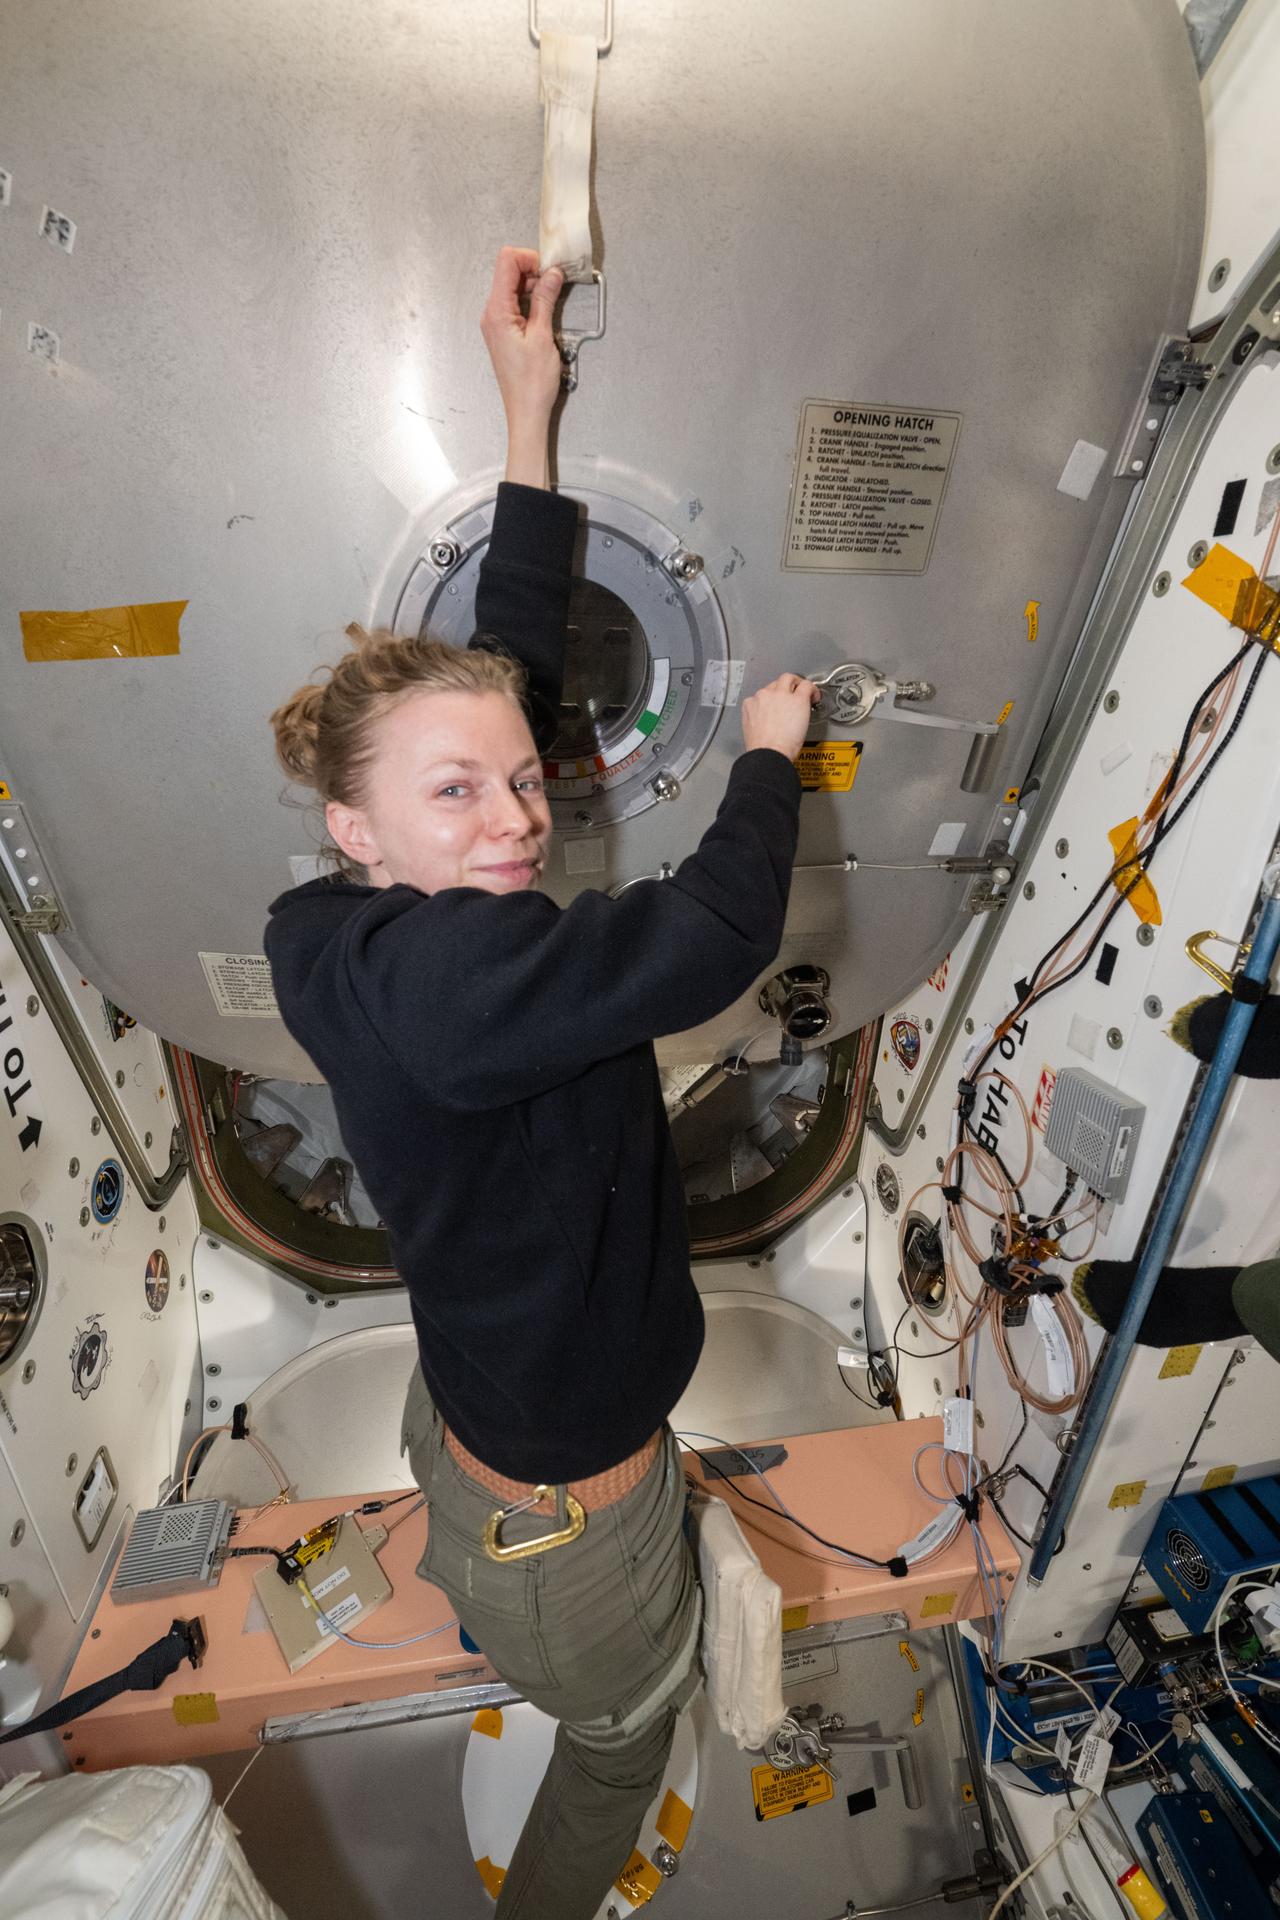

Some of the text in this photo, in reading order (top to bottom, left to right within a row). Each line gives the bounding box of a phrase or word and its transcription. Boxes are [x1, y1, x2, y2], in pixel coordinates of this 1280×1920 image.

[834, 411, 934, 430] OPENING HATCH
[821, 428, 851, 437] PRESSURE
[853, 431, 898, 441] EQUALIZATION
[900, 435, 918, 443] VALVE
[875, 443, 901, 451] Engaged
[851, 450, 879, 459] UNLATCH
[841, 458, 866, 466] HANDLE
[893, 462, 921, 471] UNLATCH
[921, 464, 946, 472] direction
[814, 474, 847, 483] INDICATOR
[854, 477, 890, 486] UNLATCHED.
[842, 494, 887, 503] EQUALIZATION
[650, 689, 678, 741] LATCHED
[840, 710, 858, 718] LATCH
[798, 752, 836, 761] ARNING
[590, 750, 644, 784] EQUALIZE
[549, 780, 577, 790] TEST
[4, 1048, 32, 1118] TO
[977, 1019, 1028, 1156] TO HAB
[336, 1572, 346, 1580] DO
[772, 1765, 810, 1781] WARNING
